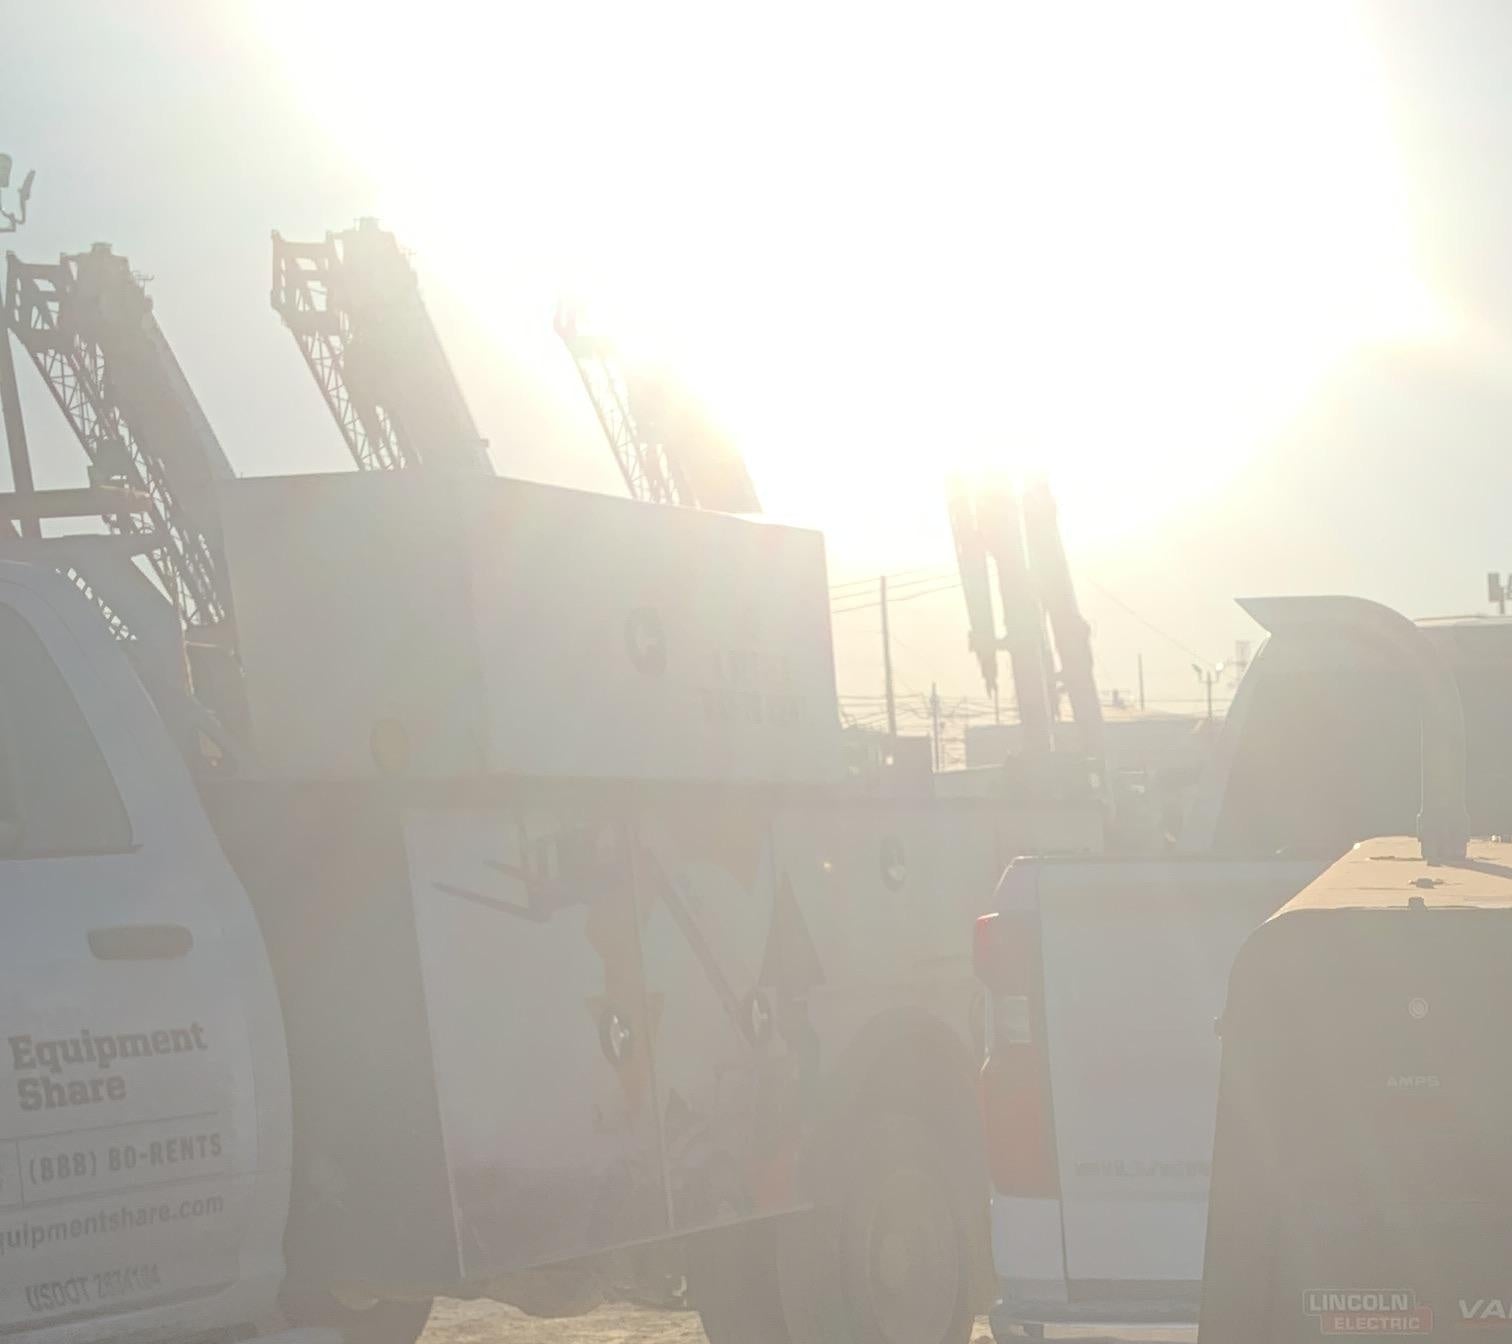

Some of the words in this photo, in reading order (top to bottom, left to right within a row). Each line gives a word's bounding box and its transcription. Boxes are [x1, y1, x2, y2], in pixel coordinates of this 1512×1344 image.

[9, 1022, 208, 1073] Equipment
[19, 1076, 128, 1110] Share
[1385, 1074, 1441, 1089] AMPS
[30, 1151, 97, 1185] (888)
[108, 1133, 223, 1171] 80-RENTS
[0, 1196, 224, 1257] uipmentshare.com
[1309, 1293, 1409, 1312] LINCOLN
[1333, 1316, 1421, 1331] ELECTRIC
